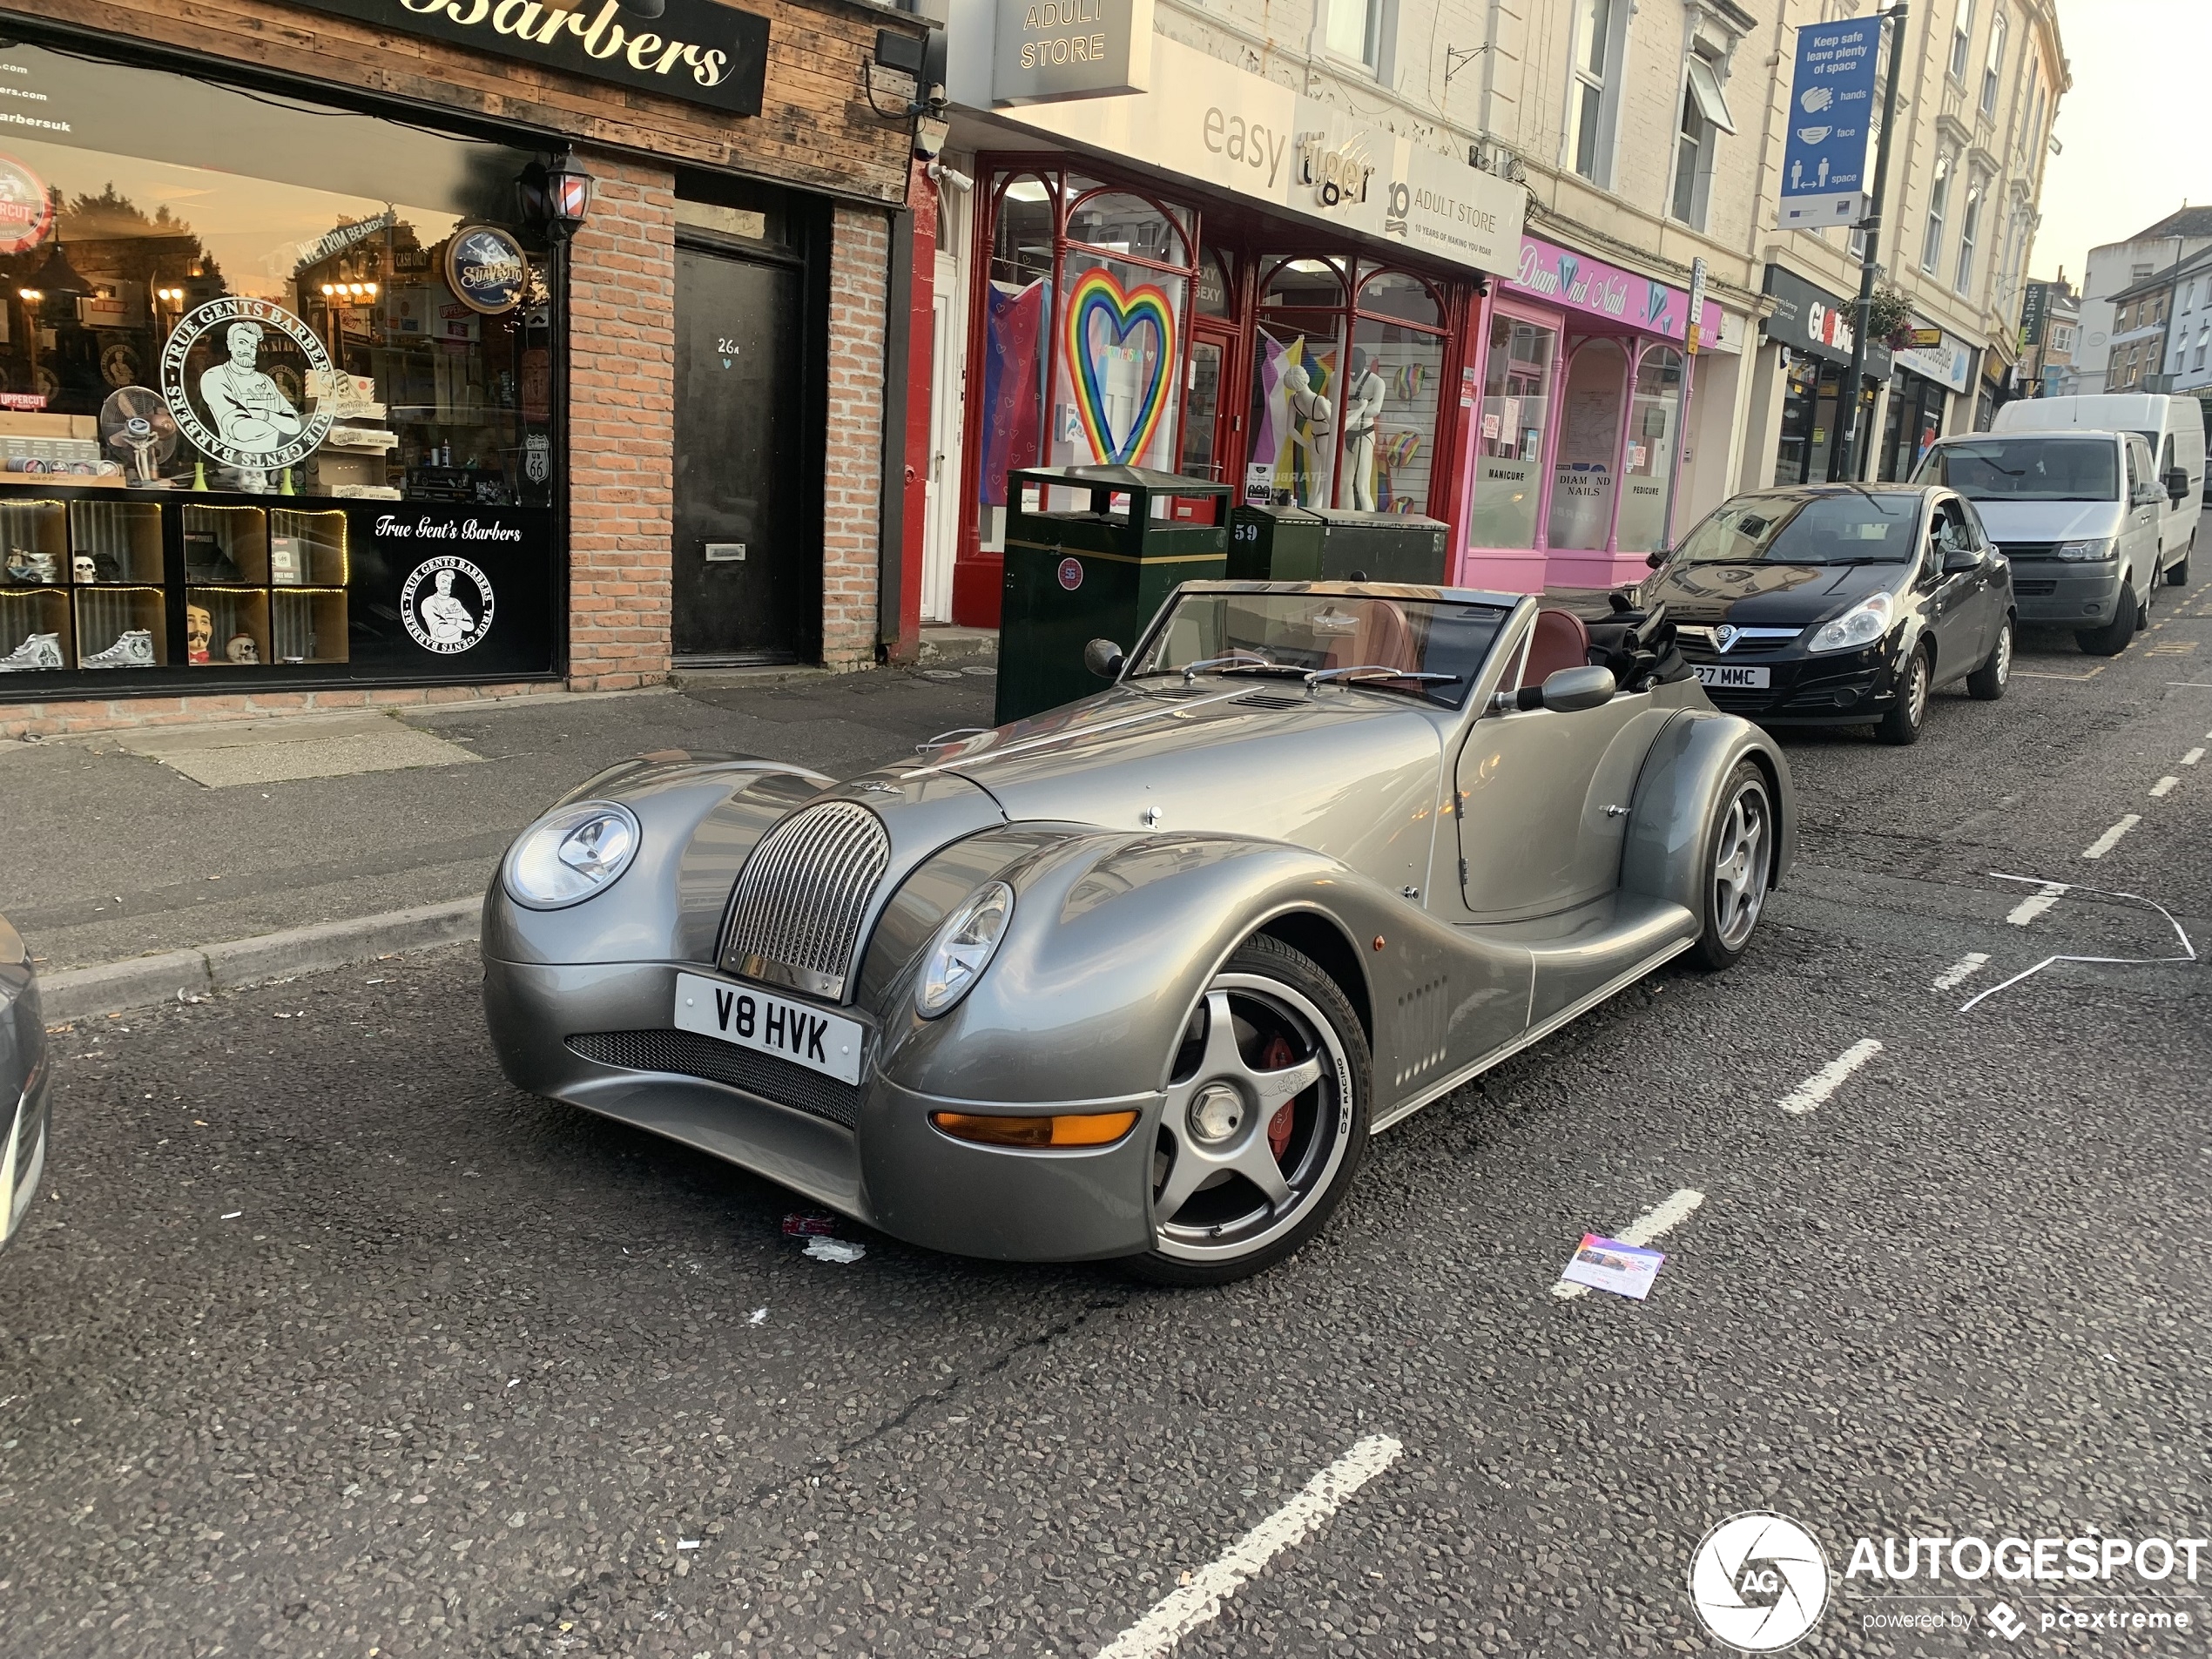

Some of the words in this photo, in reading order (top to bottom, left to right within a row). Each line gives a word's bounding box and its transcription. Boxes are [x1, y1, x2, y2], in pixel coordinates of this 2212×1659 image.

[1023, 0, 1102, 30] ADULT
[1813, 37, 1838, 47] Keep
[1841, 31, 1864, 44] safe
[1021, 33, 1105, 69] STORE
[1807, 51, 1834, 62] leave
[1836, 45, 1868, 61] plenty
[1814, 63, 1825, 75] of
[1826, 61, 1857, 75] space
[1840, 90, 1867, 101] hands
[1837, 128, 1856, 138] face
[1203, 106, 1286, 189] easy
[1297, 132, 1376, 207] tiger
[1831, 174, 1857, 185] space
[1387, 181, 1410, 219] 10
[1414, 188, 1455, 219] ADULT
[1458, 203, 1497, 235] STORE
[296, 239, 322, 265] WE
[320, 230, 349, 254] TRIM
[346, 218, 385, 242] BEARDS
[1414, 223, 1421, 233] 10
[1422, 226, 1440, 239] YEARS
[1440, 232, 1447, 241] OF
[1447, 234, 1467, 249] MAKING
[1468, 241, 1479, 252] YOU
[1479, 245, 1492, 257] ROAR
[395, 253, 412, 267] CASH
[1199, 266, 1217, 281] XY
[354, 294, 375, 304] ANDRE
[1196, 285, 1221, 302] SEXY
[1592, 273, 1629, 315] Nails
[165, 319, 199, 369] TRUE
[199, 300, 265, 324] GENTS
[268, 307, 331, 381] BARBERS
[0, 393, 45, 407] UPPERCUT
[168, 384, 237, 462] BARBERS
[241, 444, 304, 468] GENTS
[529, 460, 543, 477] 66
[1488, 469, 1525, 481] MANICURE
[1560, 475, 1588, 485] DIAM
[1596, 476, 1610, 486] ND
[1568, 486, 1601, 496] NAILS
[1633, 485, 1659, 496] PEDICURE
[374, 515, 413, 537] True
[415, 514, 460, 539] Gent's
[461, 518, 523, 542] Barbers
[1234, 523, 1258, 542] 59
[403, 571, 422, 602] TRUE
[421, 557, 457, 575] GENTS
[458, 559, 493, 602] BARBERS
[403, 609, 441, 651] BARBERS
[474, 609, 492, 637] TRUE
[442, 637, 476, 652] GENTS
[1721, 668, 1756, 685] MMC
[715, 988, 756, 1039] V8
[765, 1001, 828, 1064] HVK
[1336, 1057, 1349, 1104] RACING
